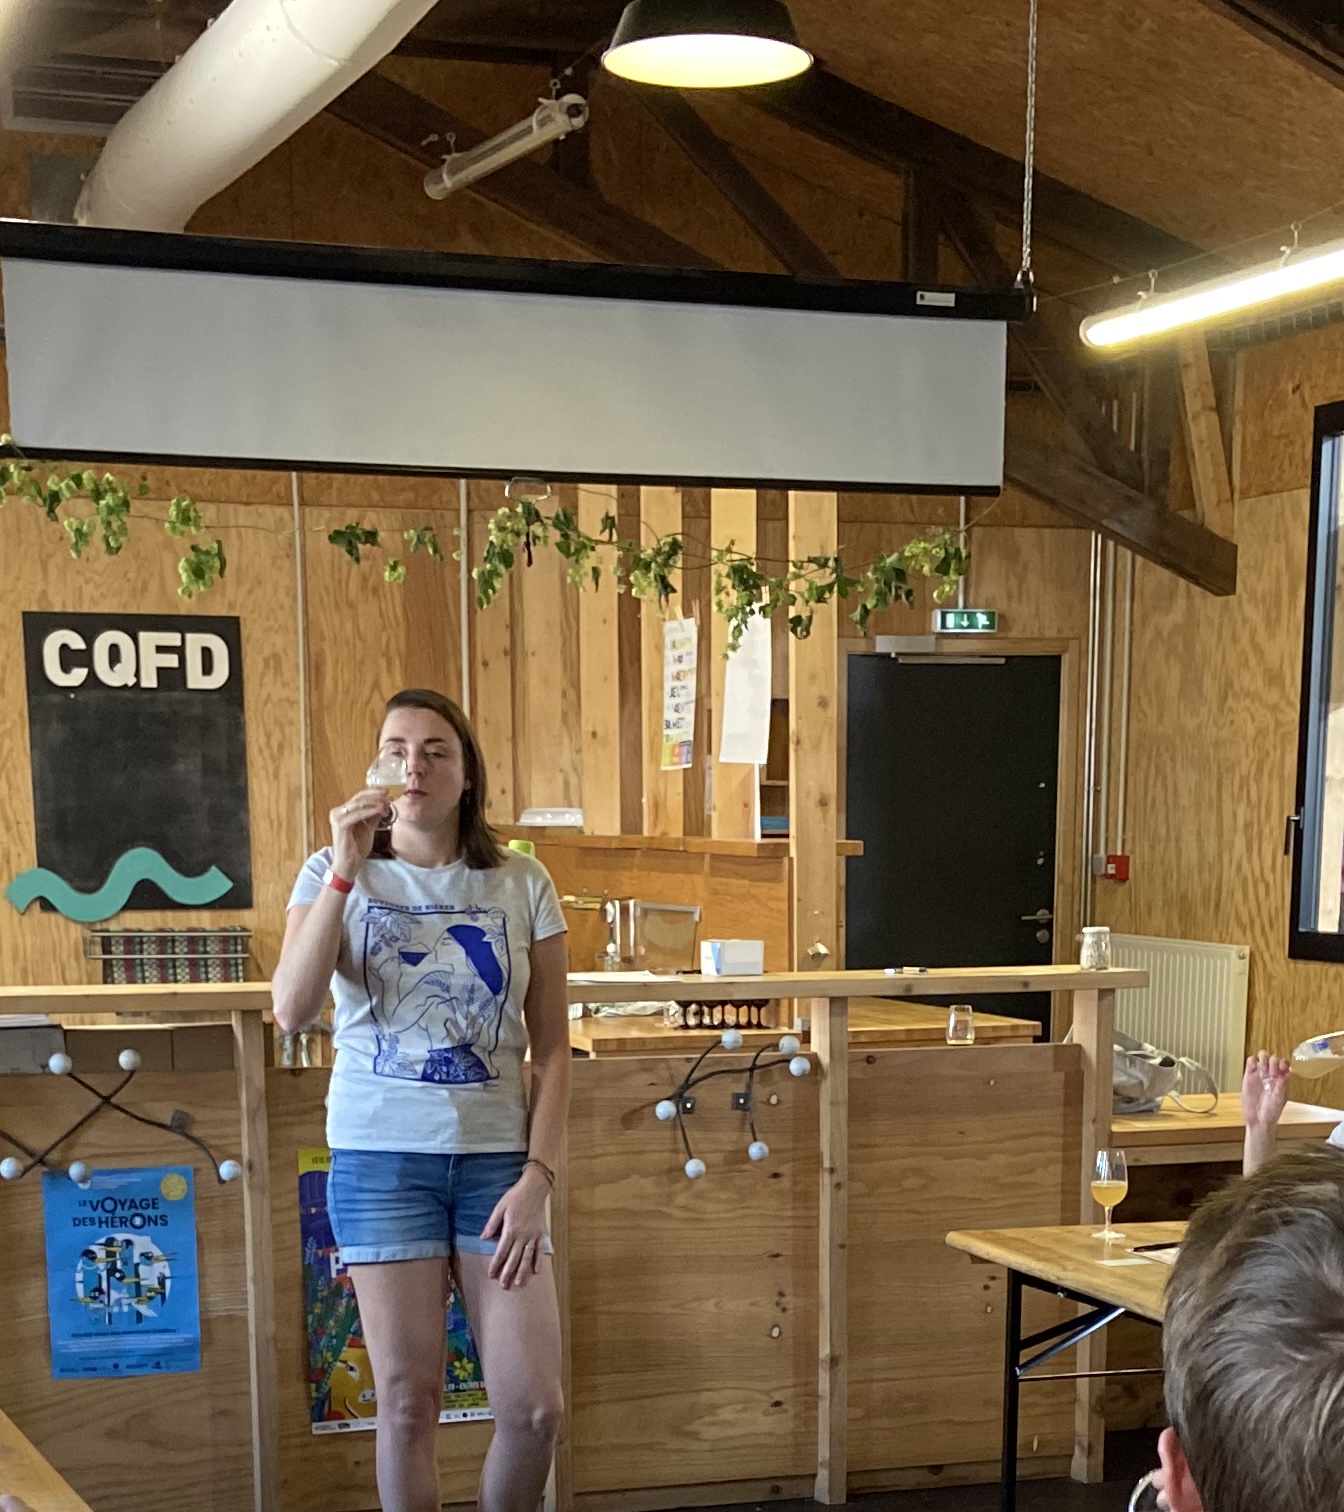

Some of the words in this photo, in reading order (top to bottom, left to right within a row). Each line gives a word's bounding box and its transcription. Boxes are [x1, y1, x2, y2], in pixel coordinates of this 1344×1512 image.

[42, 629, 230, 691] CQFD
[89, 1196, 160, 1213] VOYAGE
[72, 1217, 96, 1227] DES
